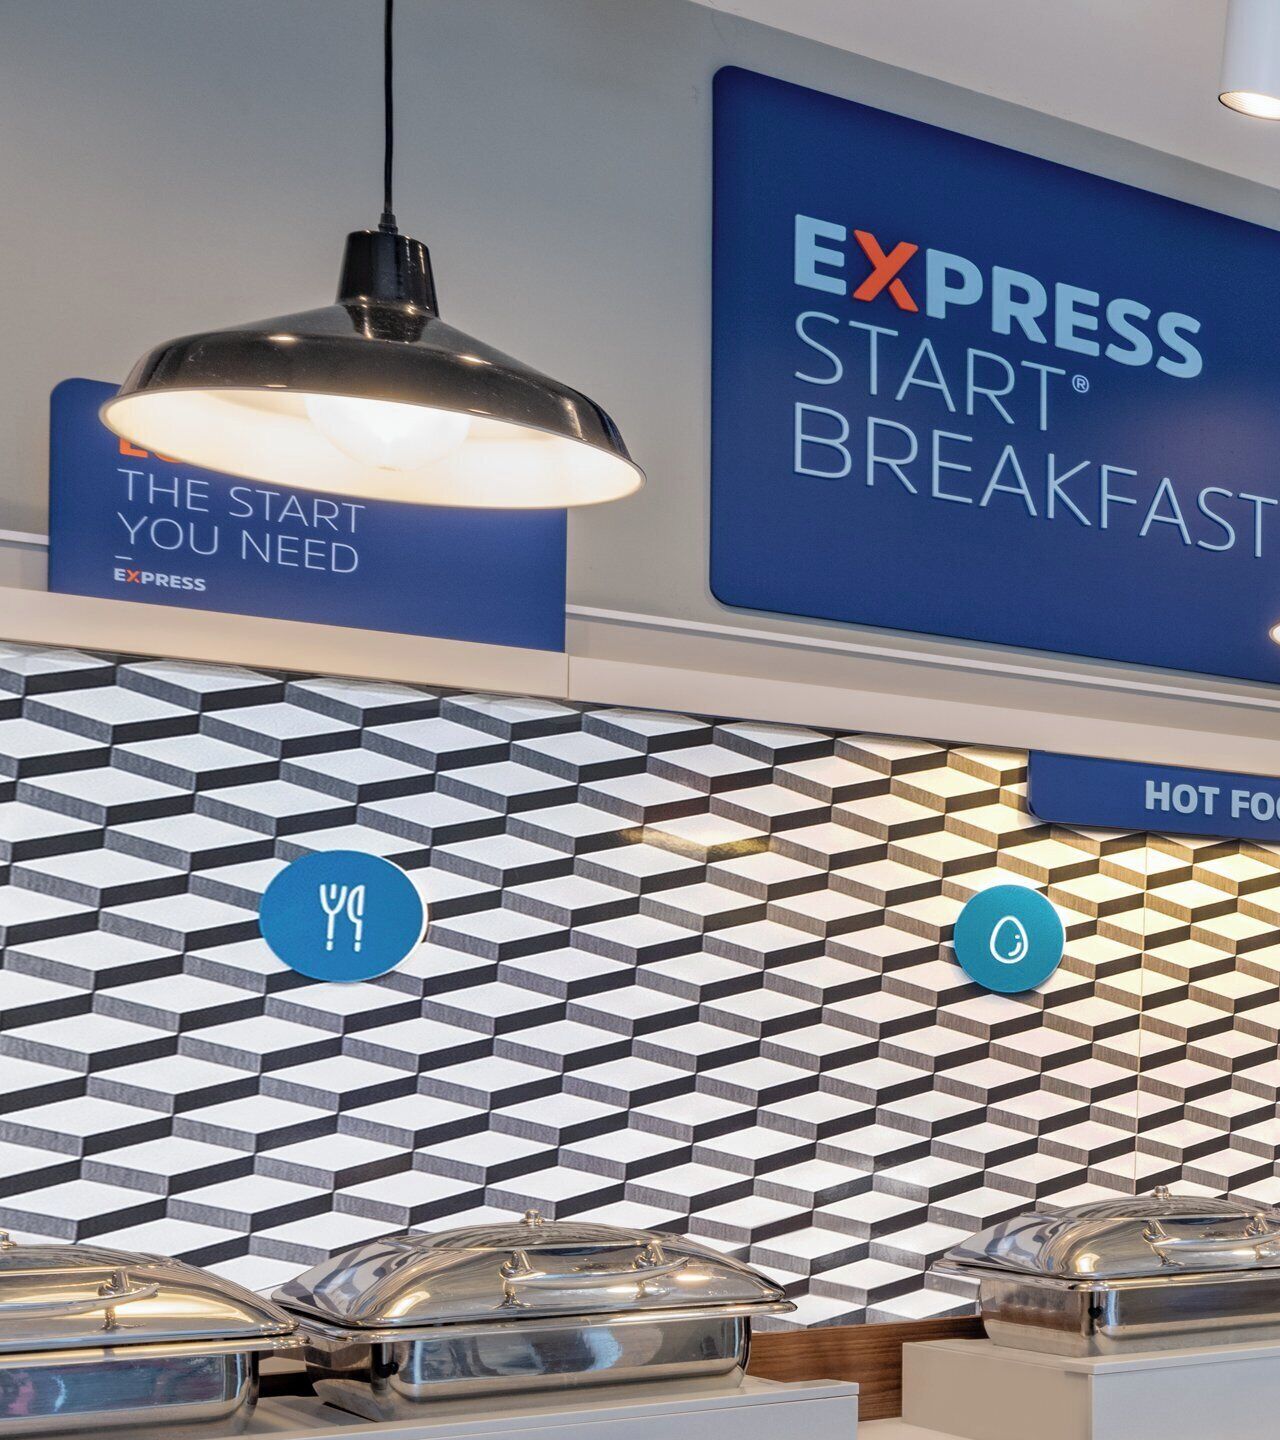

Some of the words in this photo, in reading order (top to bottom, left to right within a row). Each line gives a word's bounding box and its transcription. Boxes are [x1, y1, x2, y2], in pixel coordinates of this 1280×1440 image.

[794, 213, 1203, 380] EXPRESS
[117, 467, 210, 513] THE
[228, 486, 366, 533] START
[794, 401, 1279, 558] BREAKFAST
[117, 511, 219, 555] YOU
[241, 529, 359, 573] NEED
[113, 567, 207, 592] EXPRESS
[1145, 779, 1220, 816] HOT
